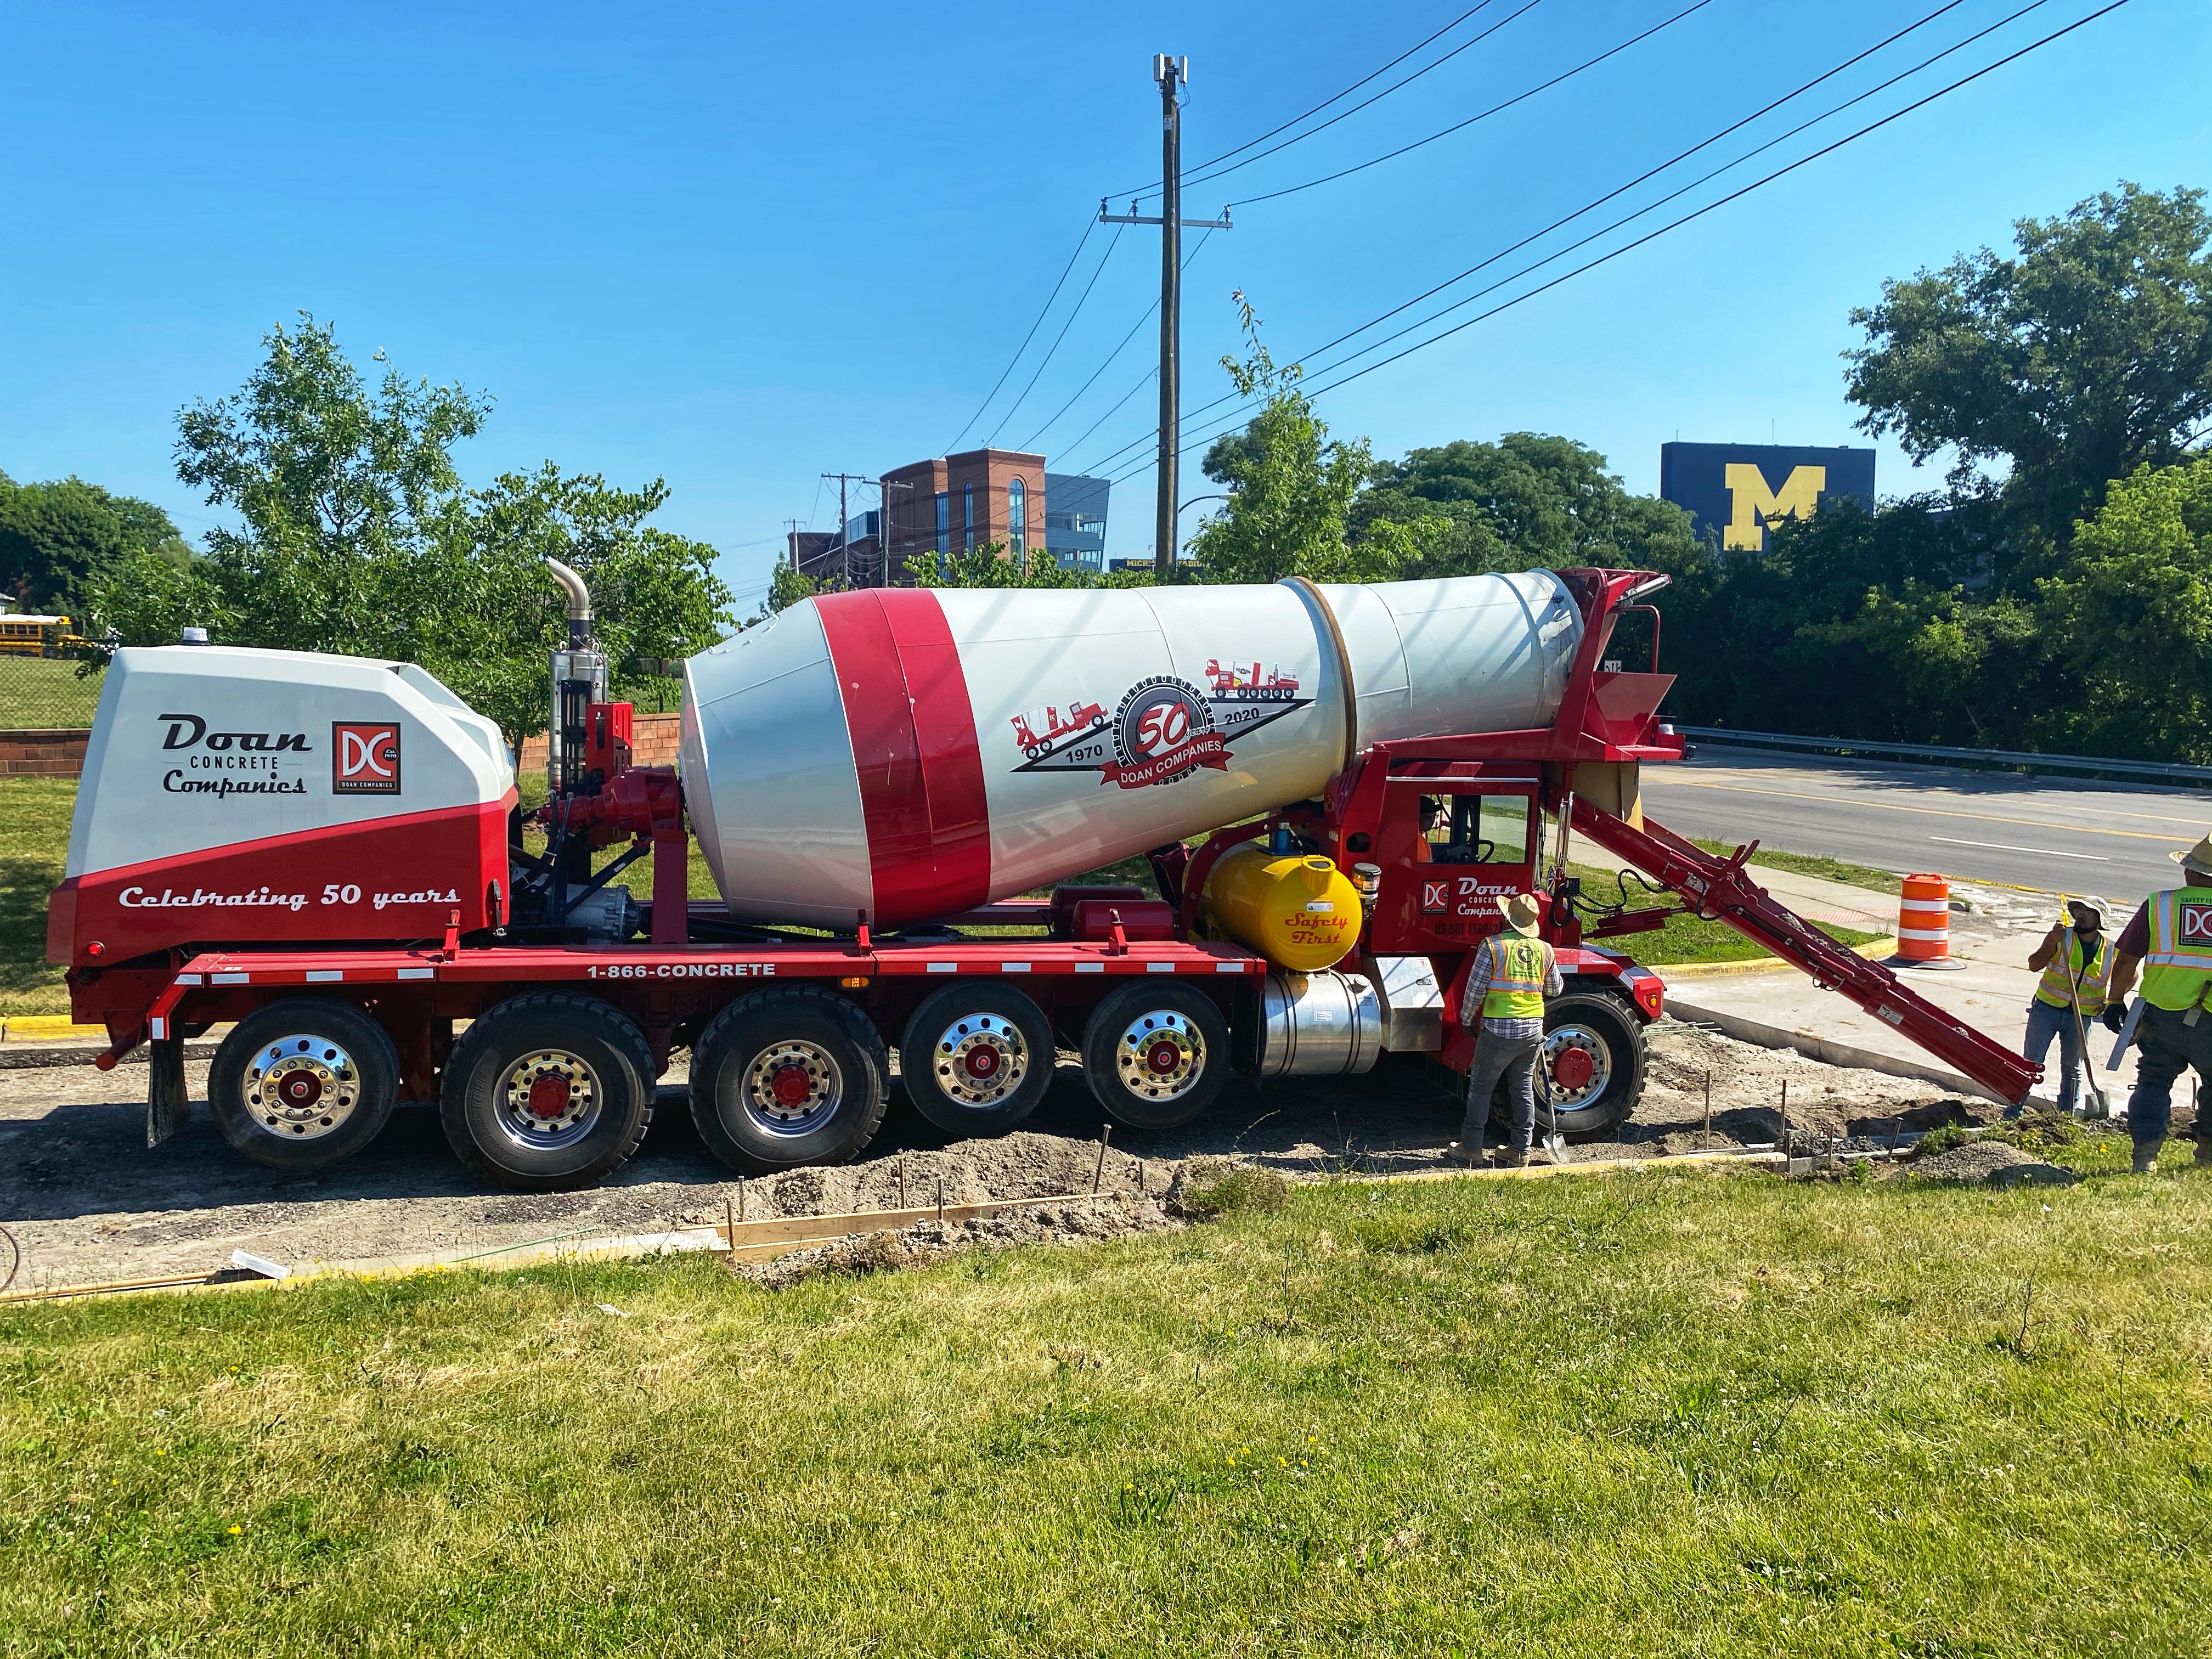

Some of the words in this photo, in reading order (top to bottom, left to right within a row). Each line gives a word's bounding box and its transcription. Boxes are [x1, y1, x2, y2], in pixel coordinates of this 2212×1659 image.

[1723, 463, 1826, 551] M
[1224, 708, 1260, 725] 2020
[157, 713, 313, 751] Doan
[1135, 702, 1189, 753] 50
[190, 756, 278, 769] CONCRETE
[342, 731, 391, 777] DC
[1066, 744, 1103, 763] 1970
[1120, 768, 1153, 783] DOAN
[1156, 740, 1221, 773] COMPANIES
[163, 769, 307, 799] Companies
[1425, 884, 1447, 906] DC
[1458, 877, 1519, 895] Doan
[119, 887, 309, 911] Celebrating
[321, 884, 362, 905] 50
[374, 888, 461, 910] years
[1285, 912, 1348, 929] Safety
[1435, 922, 1446, 934] US
[1449, 922, 1465, 934] DOT
[1292, 930, 1340, 944] First
[588, 963, 775, 978] 1-866-CONCRETE
